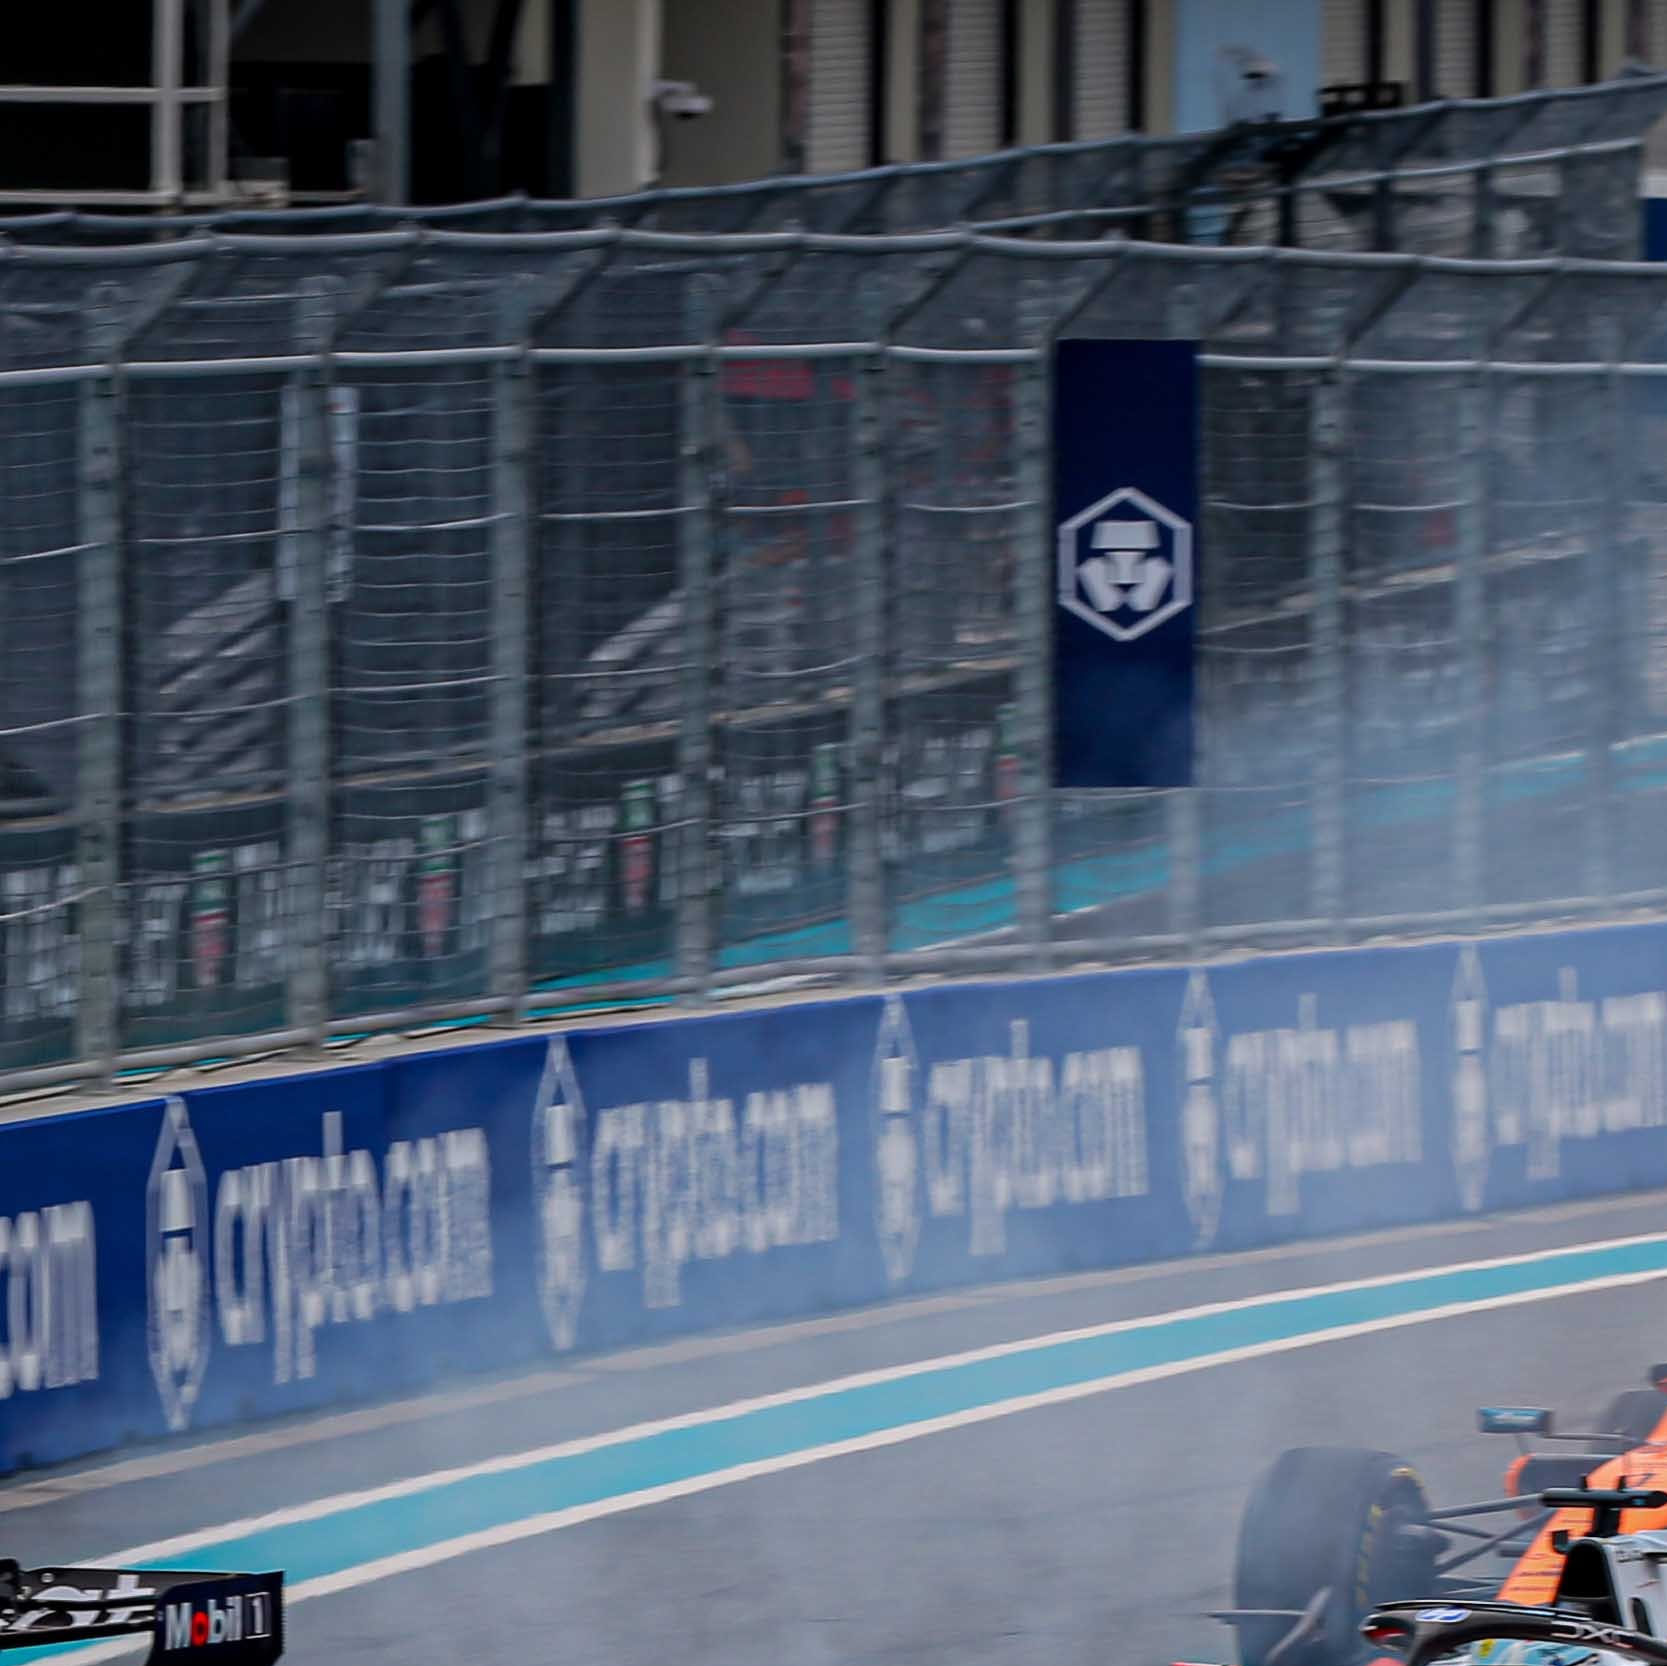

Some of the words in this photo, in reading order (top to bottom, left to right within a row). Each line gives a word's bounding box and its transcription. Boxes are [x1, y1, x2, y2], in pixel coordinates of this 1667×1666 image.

[214, 1110, 494, 1384] crypto.com
[164, 1595, 243, 1650] Mobil
[1550, 1618, 1634, 1648] DXC
